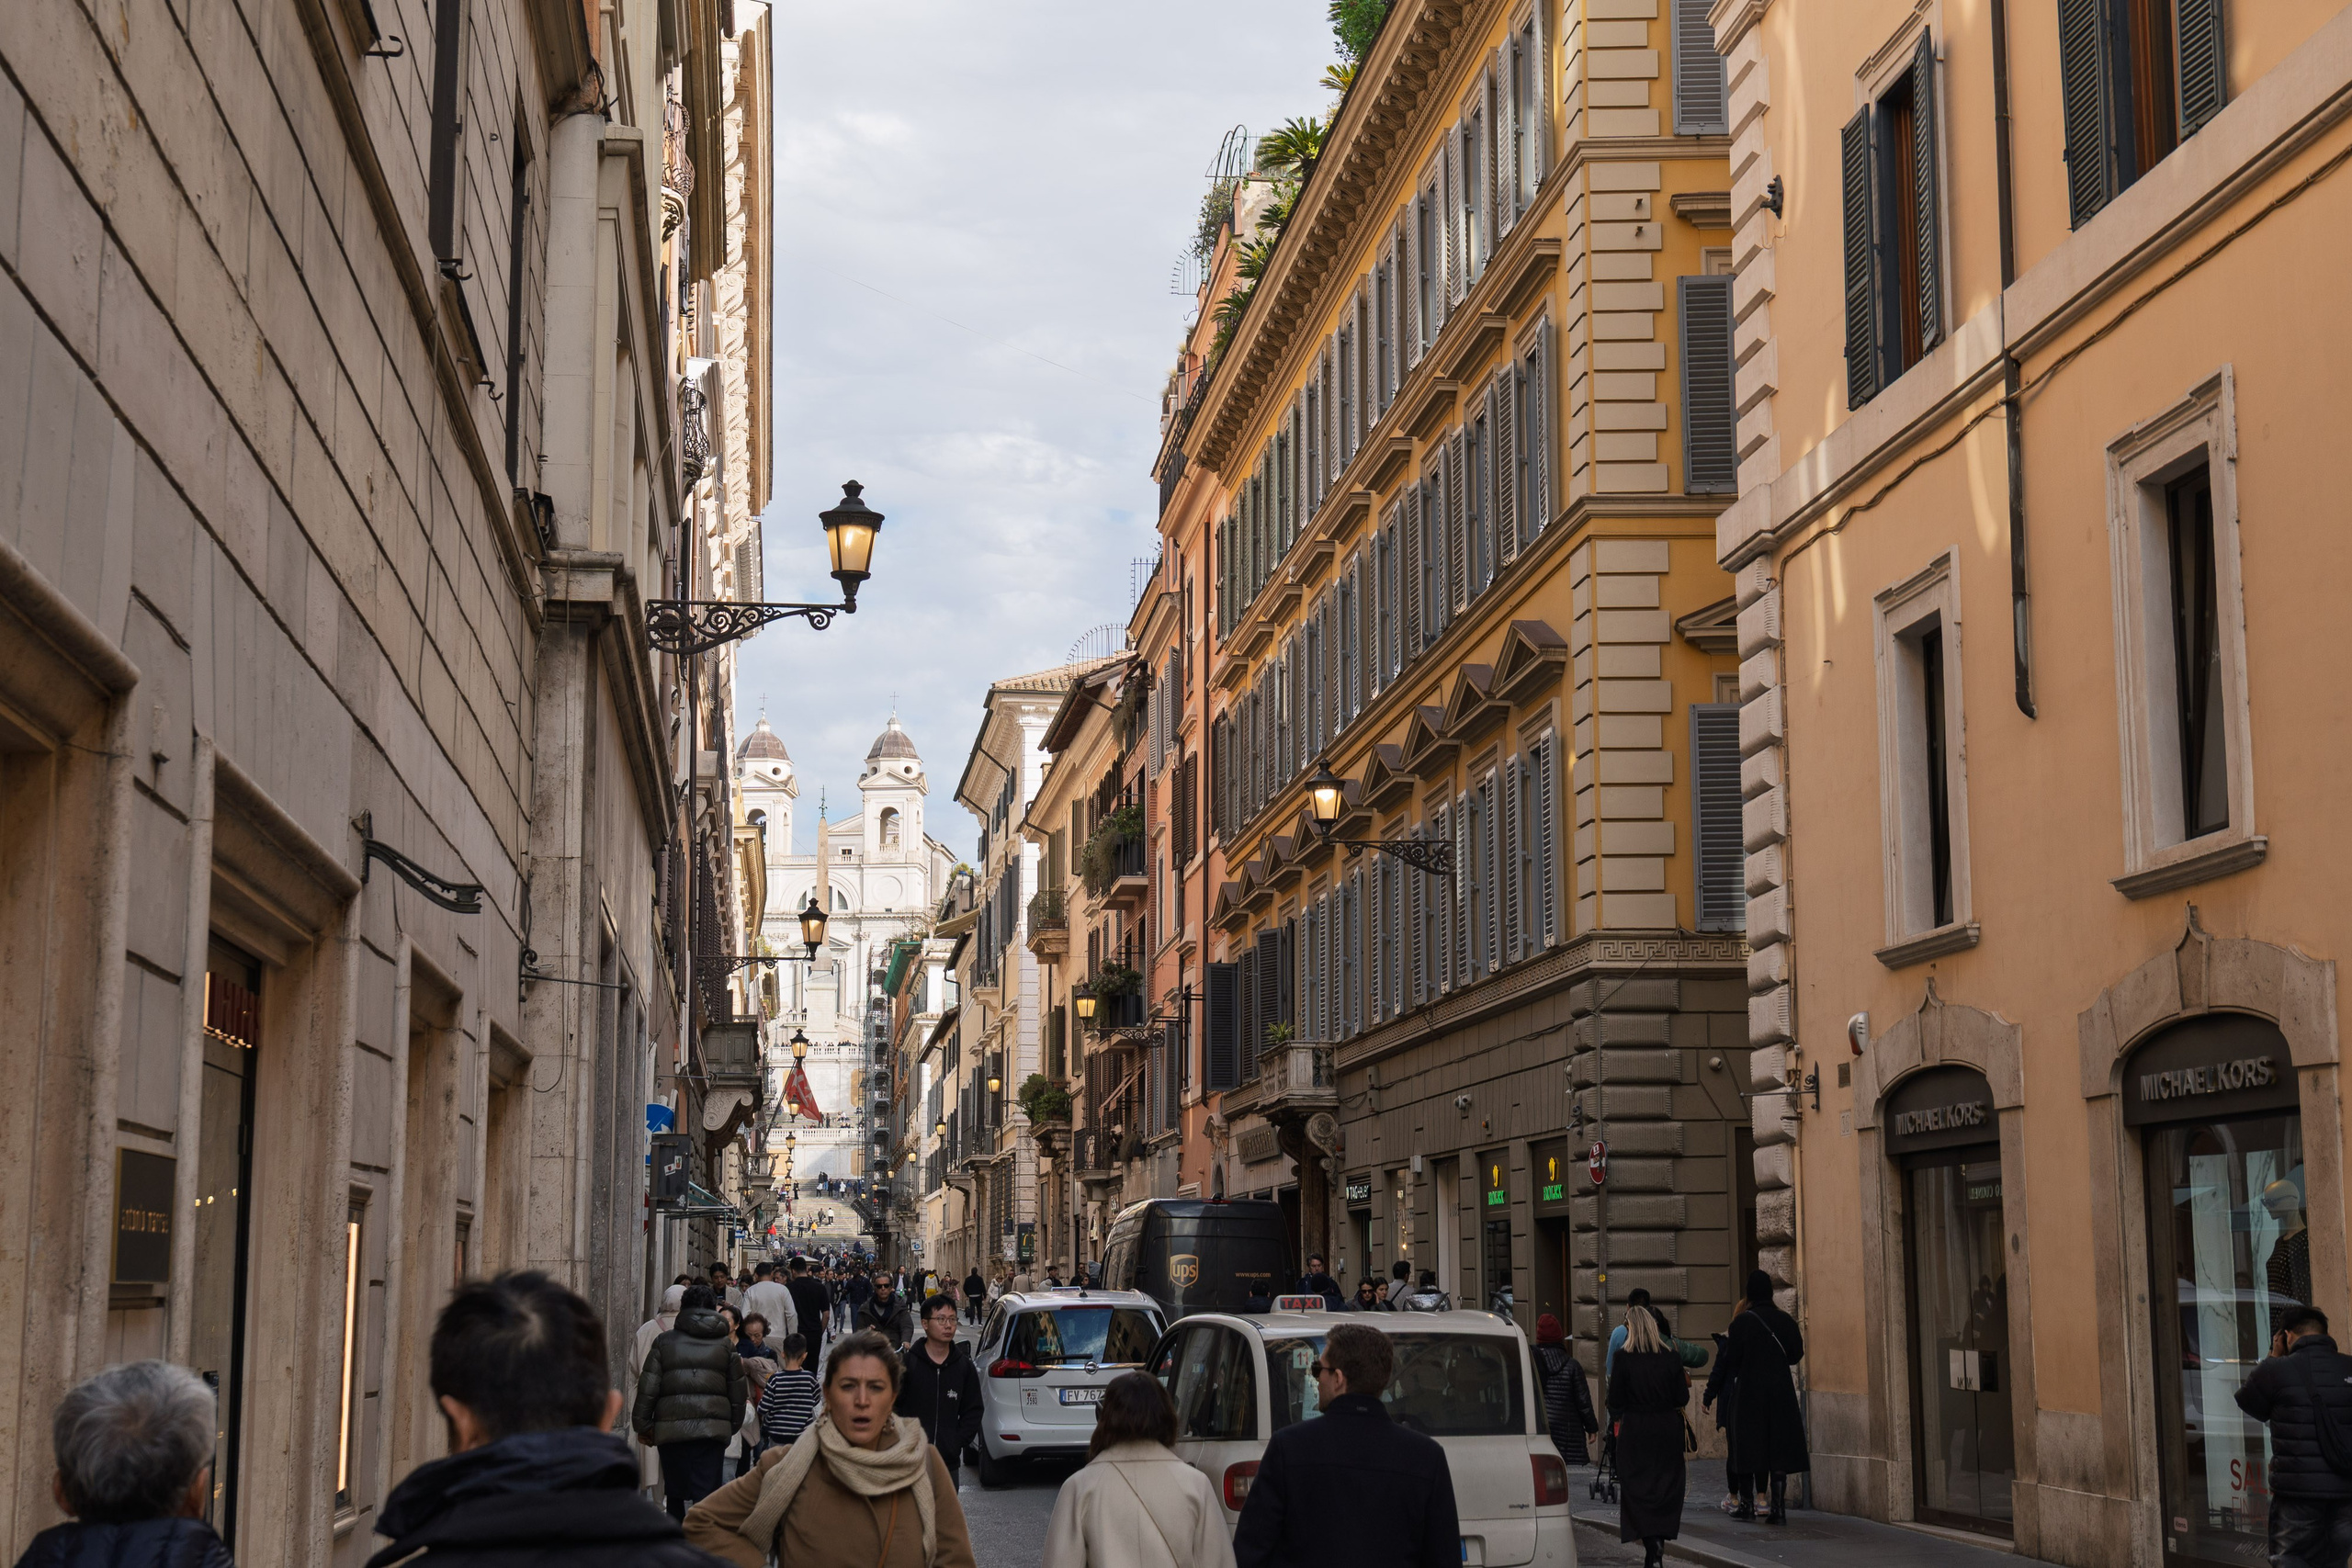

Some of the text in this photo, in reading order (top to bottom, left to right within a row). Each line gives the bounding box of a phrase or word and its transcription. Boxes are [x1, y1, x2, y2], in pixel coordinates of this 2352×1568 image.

[2140, 1056, 2270, 1101] MICHAEL KORS
[1895, 1101, 1982, 1135] MICHAEL KORS
[1172, 1264, 1196, 1282] ups
[1282, 1297, 1320, 1309] TAXI
[1297, 1351, 1308, 1366] 11
[1067, 1389, 1106, 1401] FV 767
[2230, 1458, 2275, 1496] SAL
